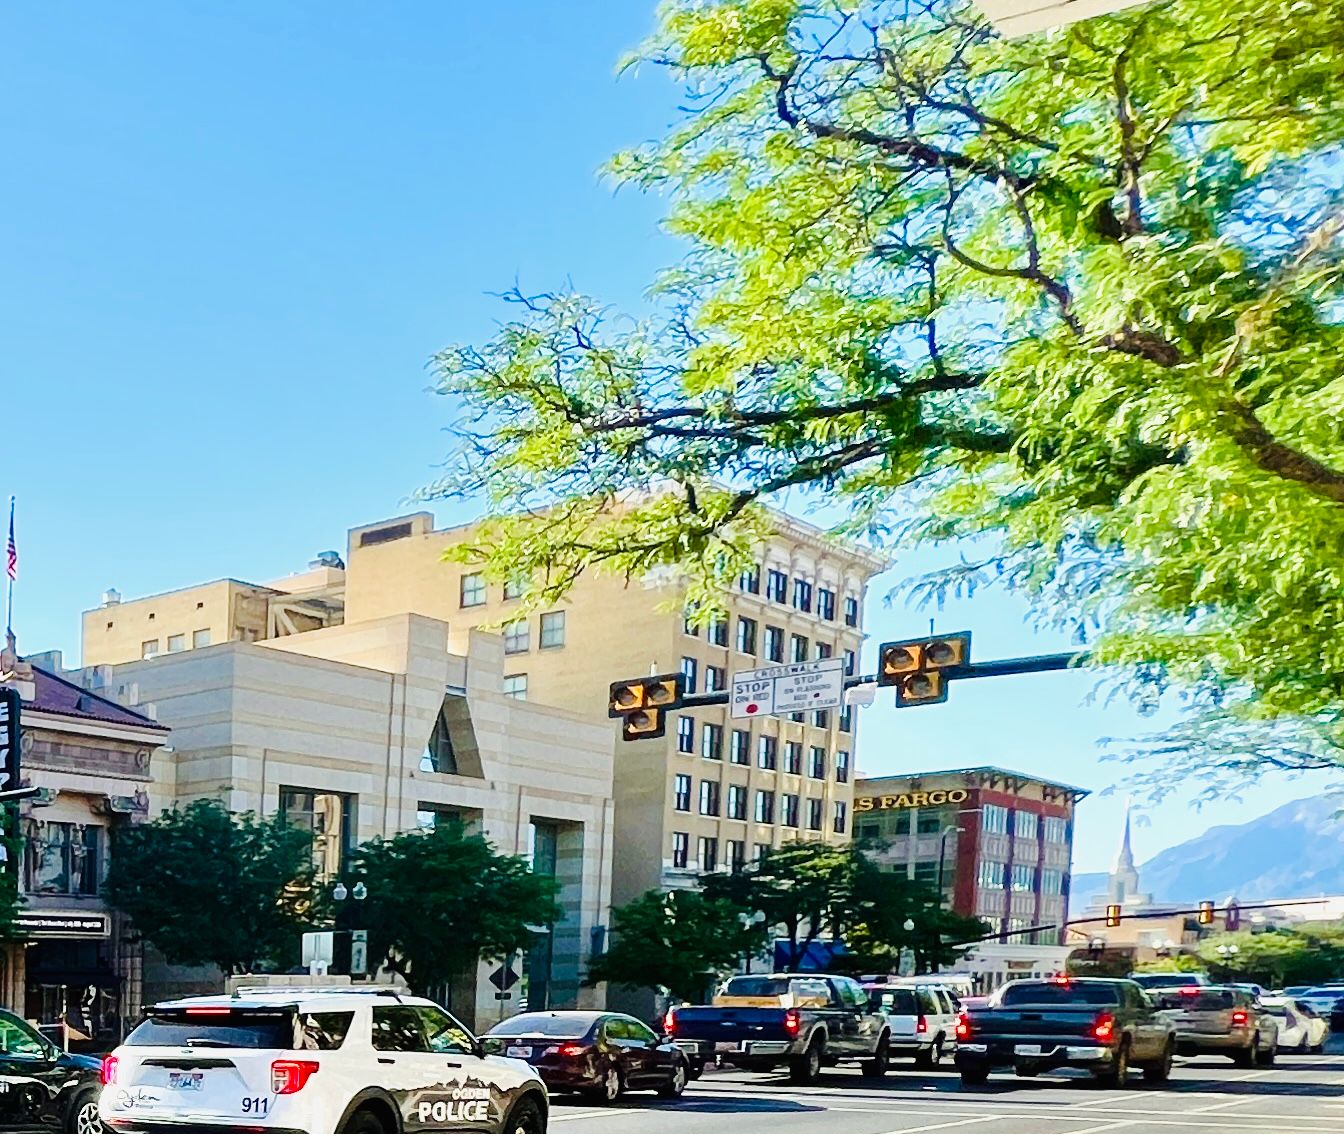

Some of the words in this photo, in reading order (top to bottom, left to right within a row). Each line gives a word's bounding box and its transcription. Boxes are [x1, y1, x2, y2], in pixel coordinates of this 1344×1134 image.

[754, 664, 820, 680] CROSSWALK
[794, 674, 823, 685] STOP
[736, 682, 770, 694] STOP
[879, 789, 968, 809] FARGO
[452, 1087, 491, 1101] OGDEN
[242, 1097, 268, 1113] 911
[418, 1101, 490, 1123] POLICE
